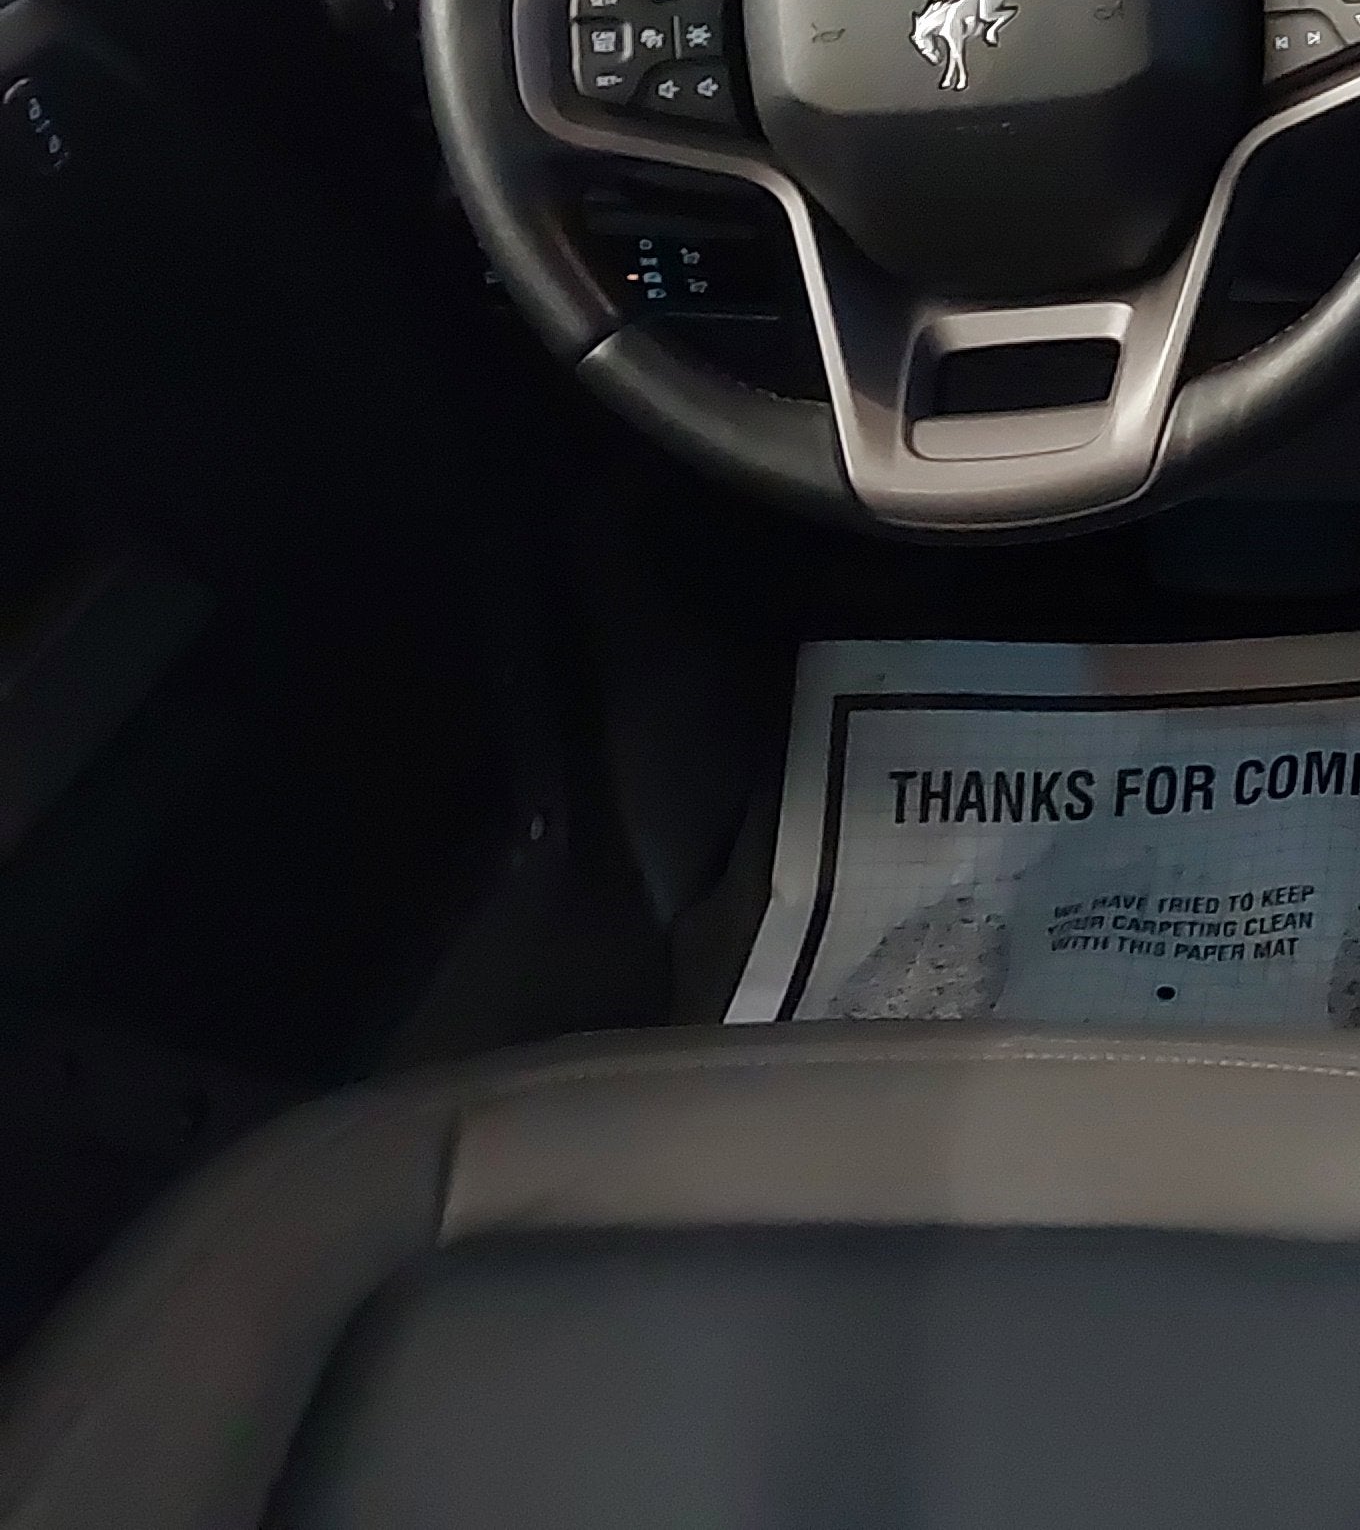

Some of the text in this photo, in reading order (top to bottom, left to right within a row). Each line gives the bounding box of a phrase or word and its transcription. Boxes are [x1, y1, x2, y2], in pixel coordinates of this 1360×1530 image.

[890, 768, 1095, 825] THANKS
[1113, 761, 1217, 819] FOR
[1092, 894, 1148, 911] HAVE
[1158, 896, 1220, 915] TRIED
[1228, 892, 1254, 914] TO
[1262, 884, 1315, 909] KEEP
[1112, 915, 1238, 938] CARPETING
[1244, 911, 1314, 938] CLEAN
[1051, 935, 1300, 962] WITH THIS PAPER MAT
